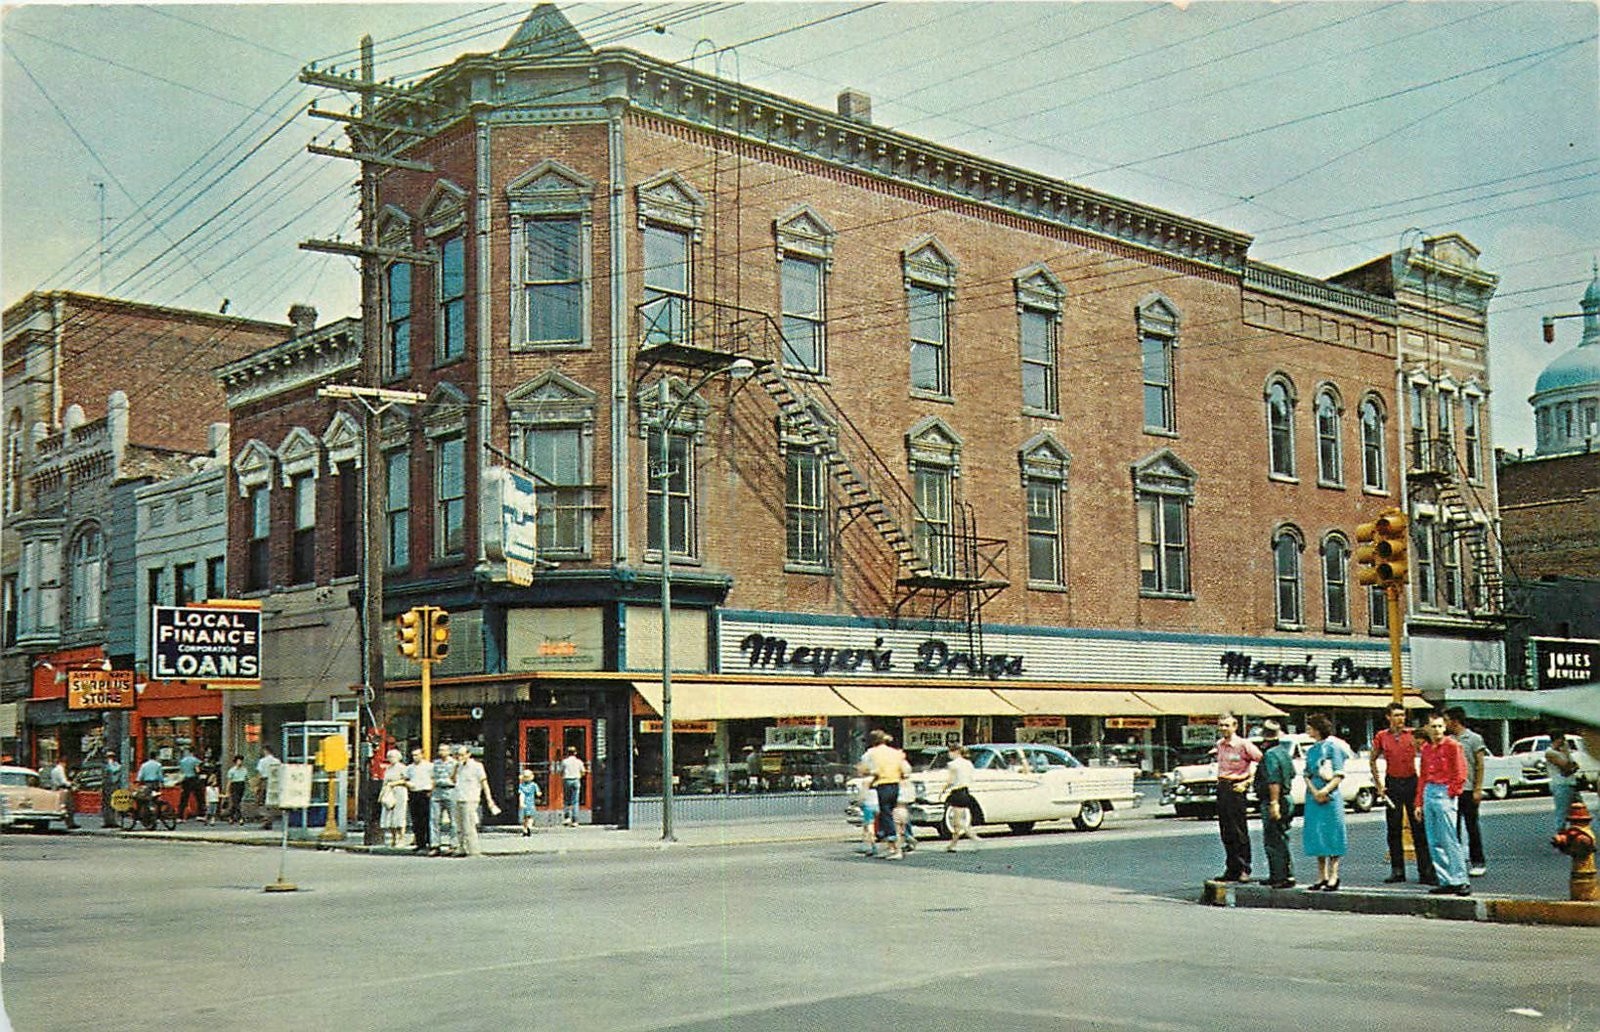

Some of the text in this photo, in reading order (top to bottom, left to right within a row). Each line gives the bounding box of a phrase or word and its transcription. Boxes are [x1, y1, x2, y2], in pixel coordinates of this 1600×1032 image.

[174, 610, 245, 628] LOCAL
[160, 625, 256, 644] FINANCE
[177, 643, 237, 653] CORPORATION
[157, 654, 257, 676] LOANS
[82, 692, 121, 704] STORE
